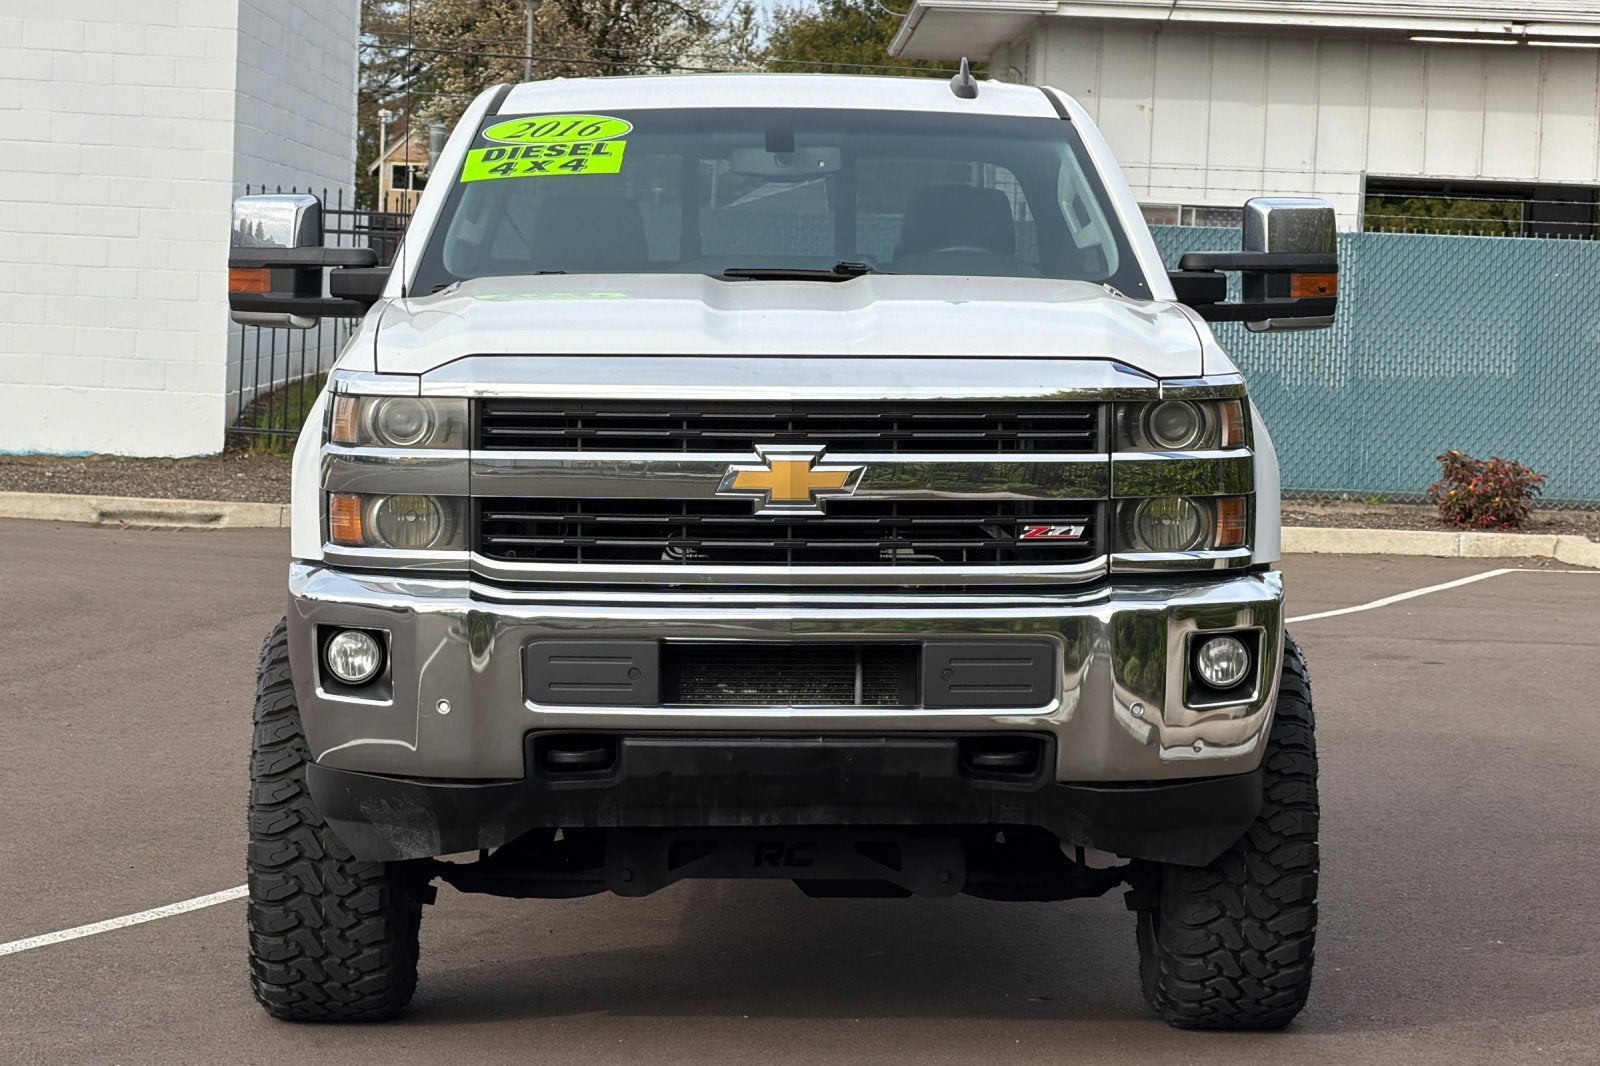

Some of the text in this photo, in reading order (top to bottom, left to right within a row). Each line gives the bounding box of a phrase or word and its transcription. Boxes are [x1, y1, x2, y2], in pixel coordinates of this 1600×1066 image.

[505, 120, 612, 139] 2016
[481, 143, 612, 162] DIESEL
[1019, 525, 1085, 539] Z71
[753, 840, 816, 867] RC
